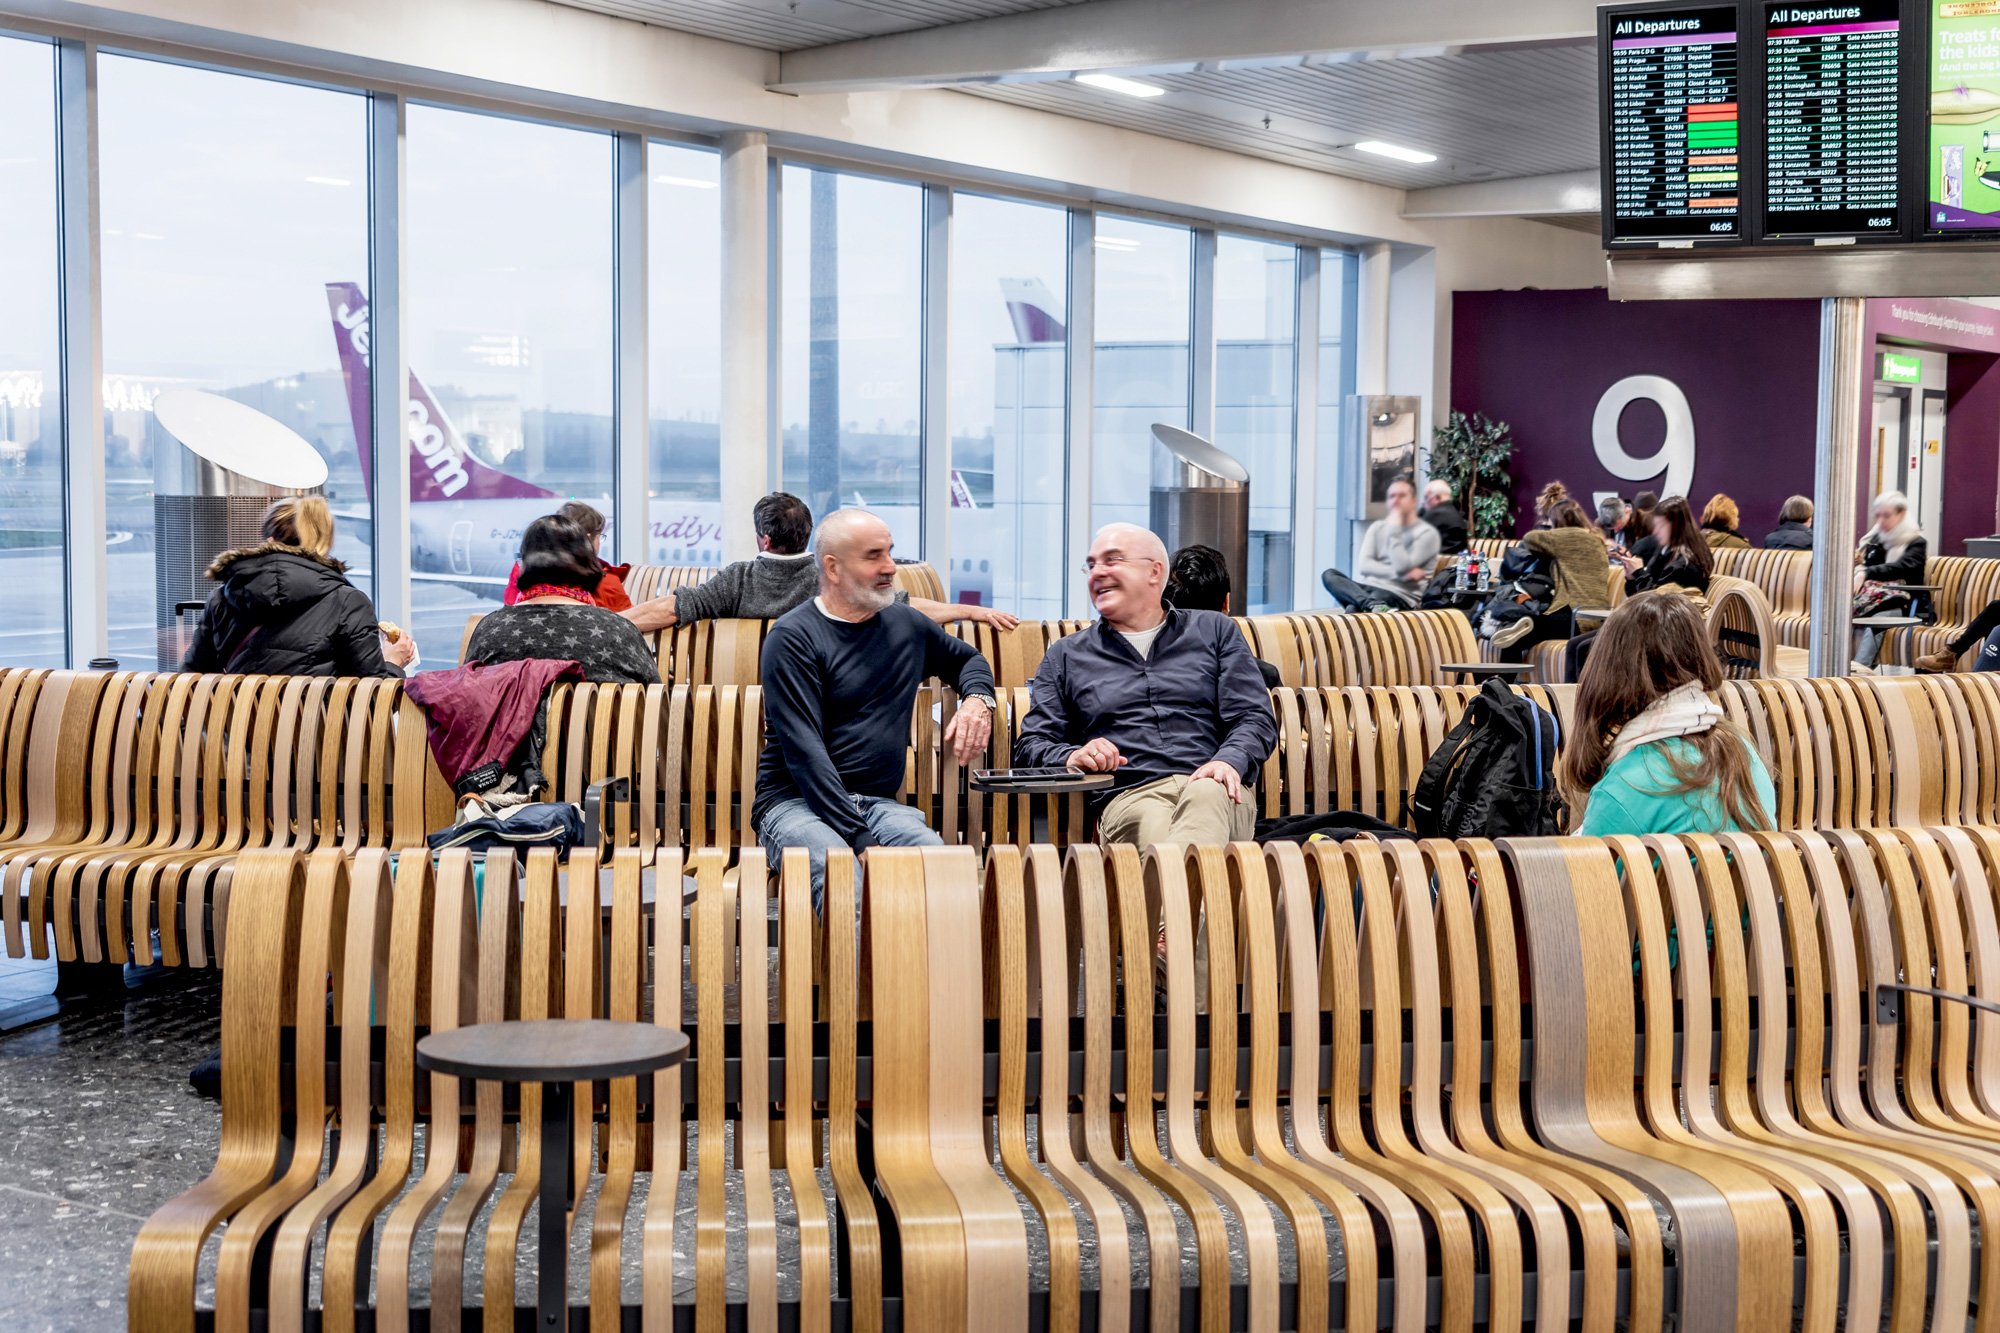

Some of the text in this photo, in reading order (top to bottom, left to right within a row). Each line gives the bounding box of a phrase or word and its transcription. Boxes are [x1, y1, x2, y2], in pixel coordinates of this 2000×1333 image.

[1770, 8, 1860, 23] All Departures
[1616, 19, 1700, 34] All Departures
[1939, 30, 1986, 44] Treats
[1688, 45, 1711, 53] Departed
[1939, 45, 1964, 60] the
[1688, 54, 1711, 62] Departed
[1688, 62, 1712, 70] Departed
[1964, 62, 1978, 71] the
[1688, 71, 1712, 79] Departed
[1784, 82, 1815, 90] Birmingham
[1868, 218, 1892, 226] 06:05
[1710, 222, 1732, 232] 06:05
[1592, 375, 1695, 512] 9
